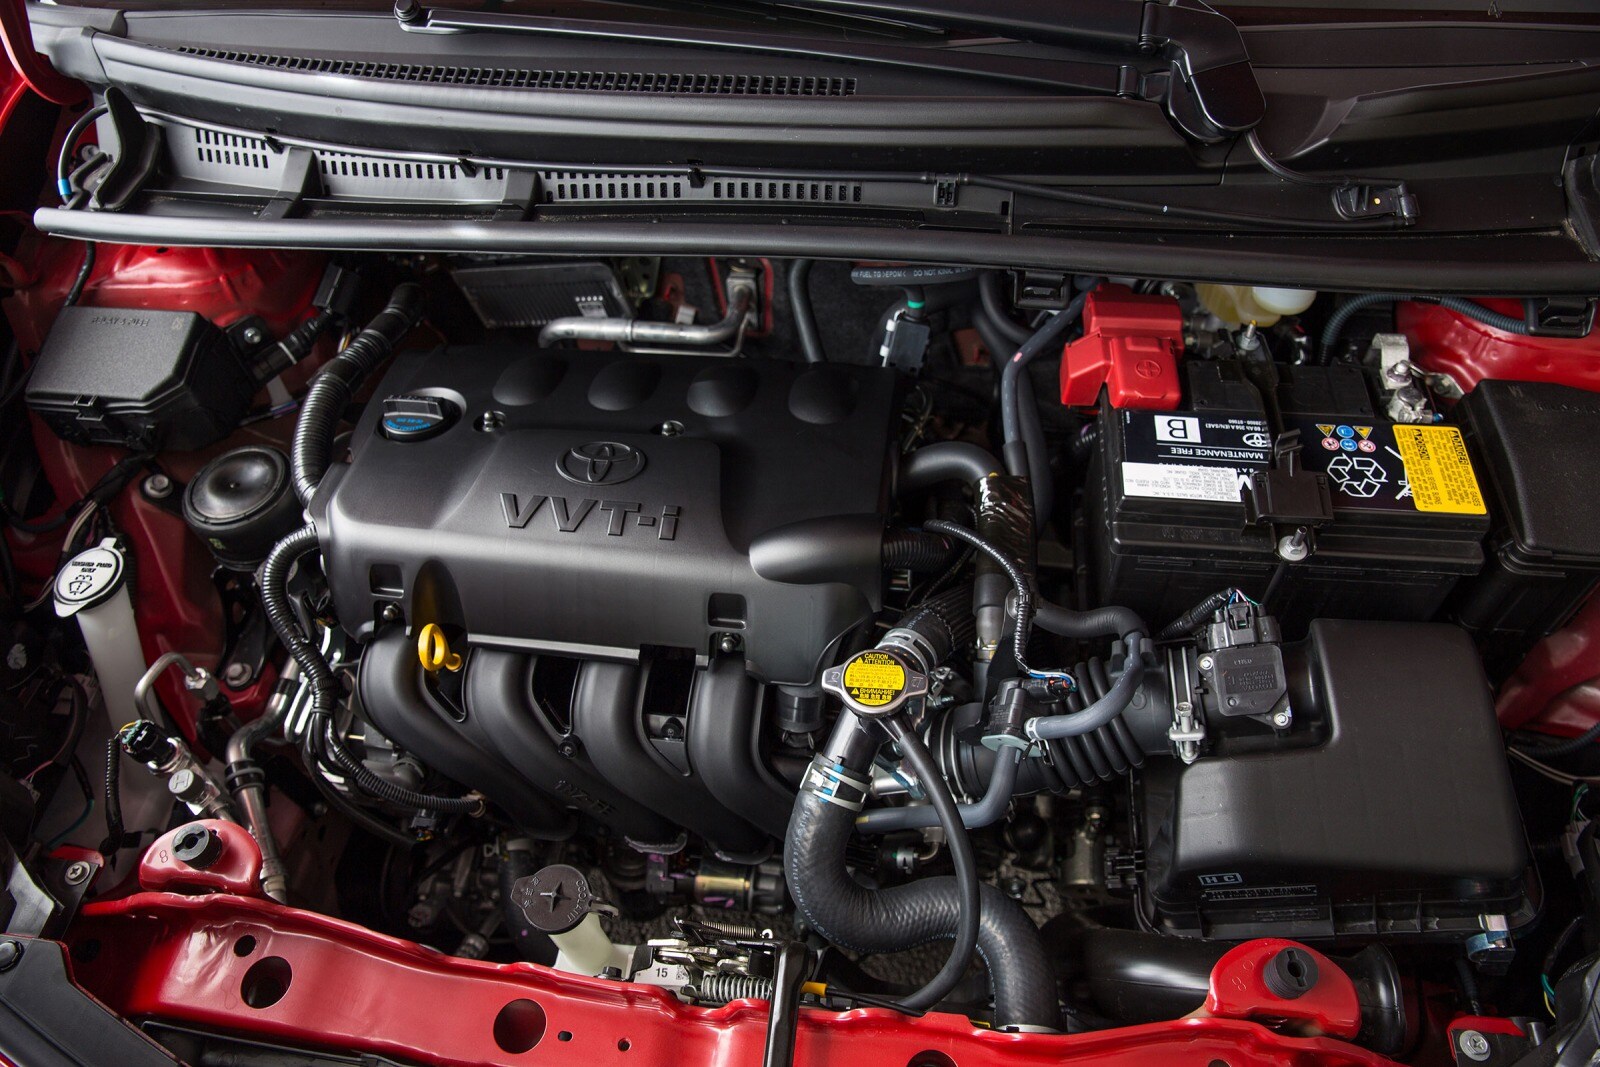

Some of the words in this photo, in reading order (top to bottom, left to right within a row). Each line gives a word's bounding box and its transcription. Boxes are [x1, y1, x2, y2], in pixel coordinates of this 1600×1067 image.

[1166, 418, 1188, 439] B
[1170, 447, 1193, 455] FREE
[1195, 448, 1264, 460] MAINTENANCE
[1414, 435, 1430, 460] POISON
[1452, 437, 1469, 465] DANGER
[1470, 490, 1482, 507] GASES
[500, 492, 682, 540] VVT-i
[655, 967, 668, 978] 15
